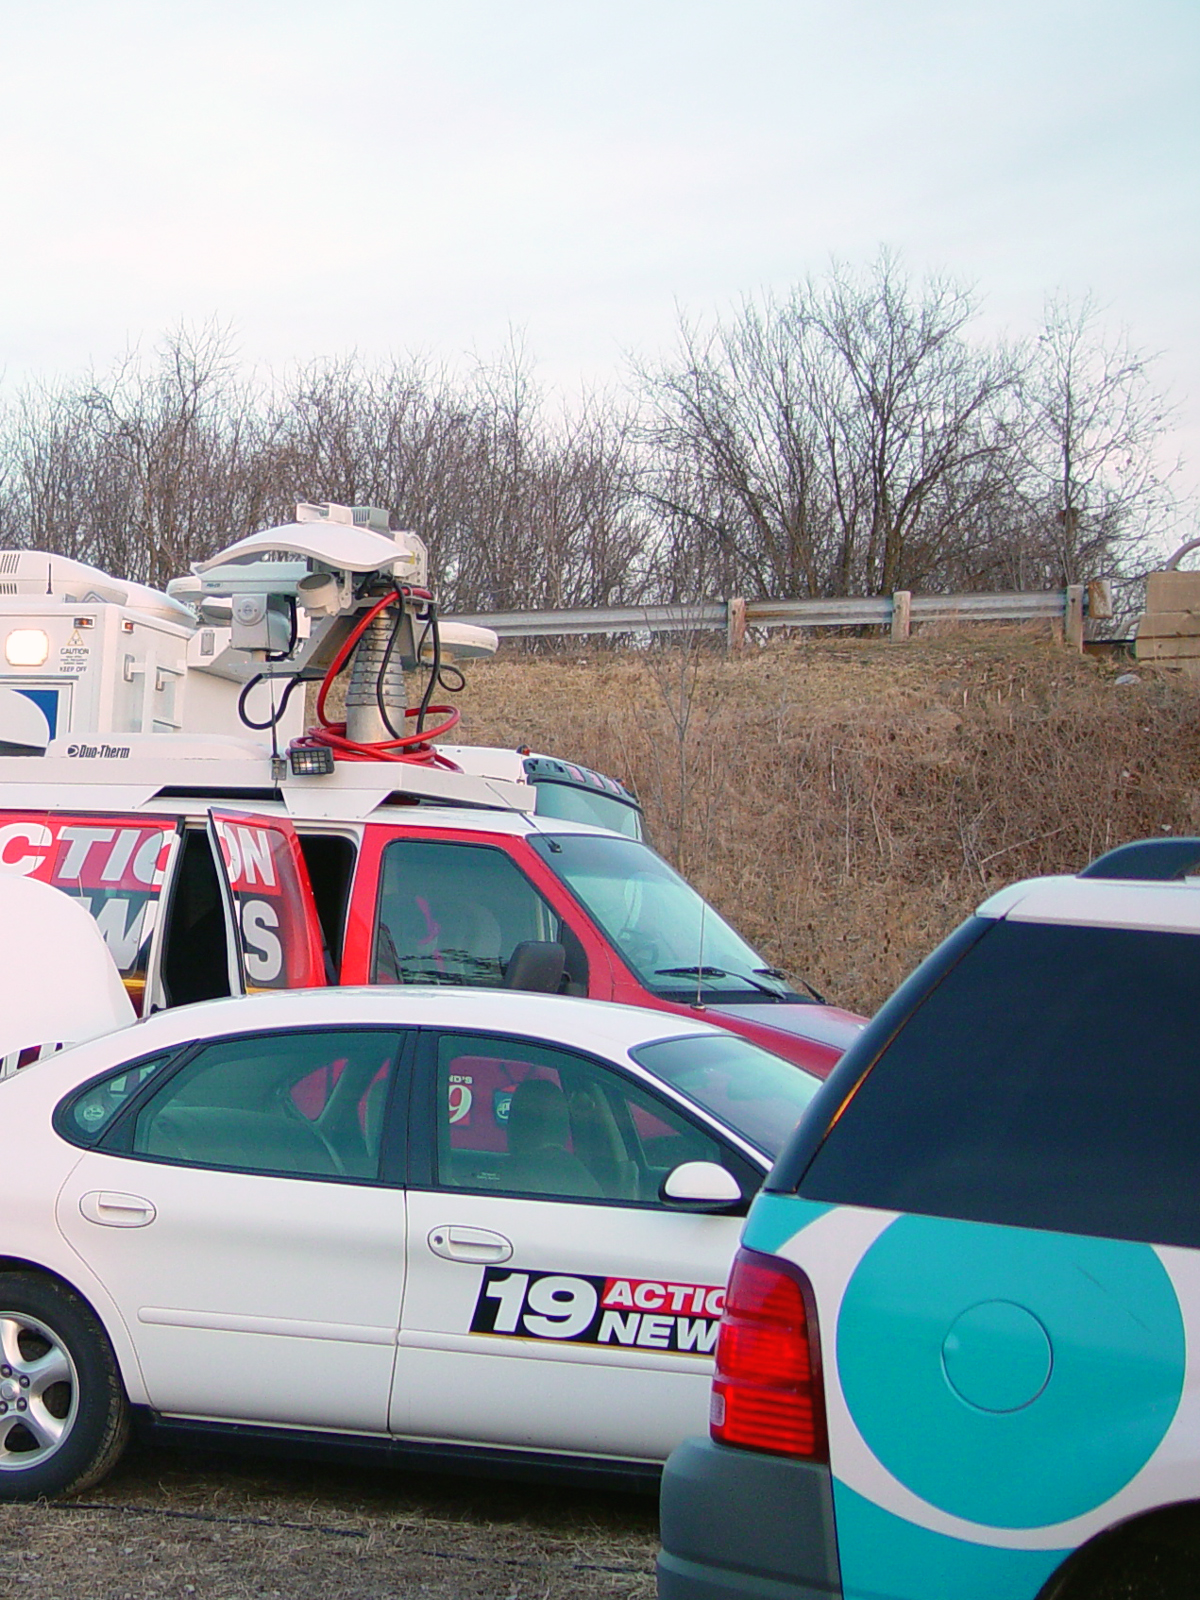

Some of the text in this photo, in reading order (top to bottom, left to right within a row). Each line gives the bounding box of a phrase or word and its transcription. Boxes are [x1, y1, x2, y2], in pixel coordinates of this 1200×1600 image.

[79, 744, 130, 758] Duo-Therm
[485, 1272, 726, 1338] 19 ACTIO
[597, 1310, 720, 1353] NEW
